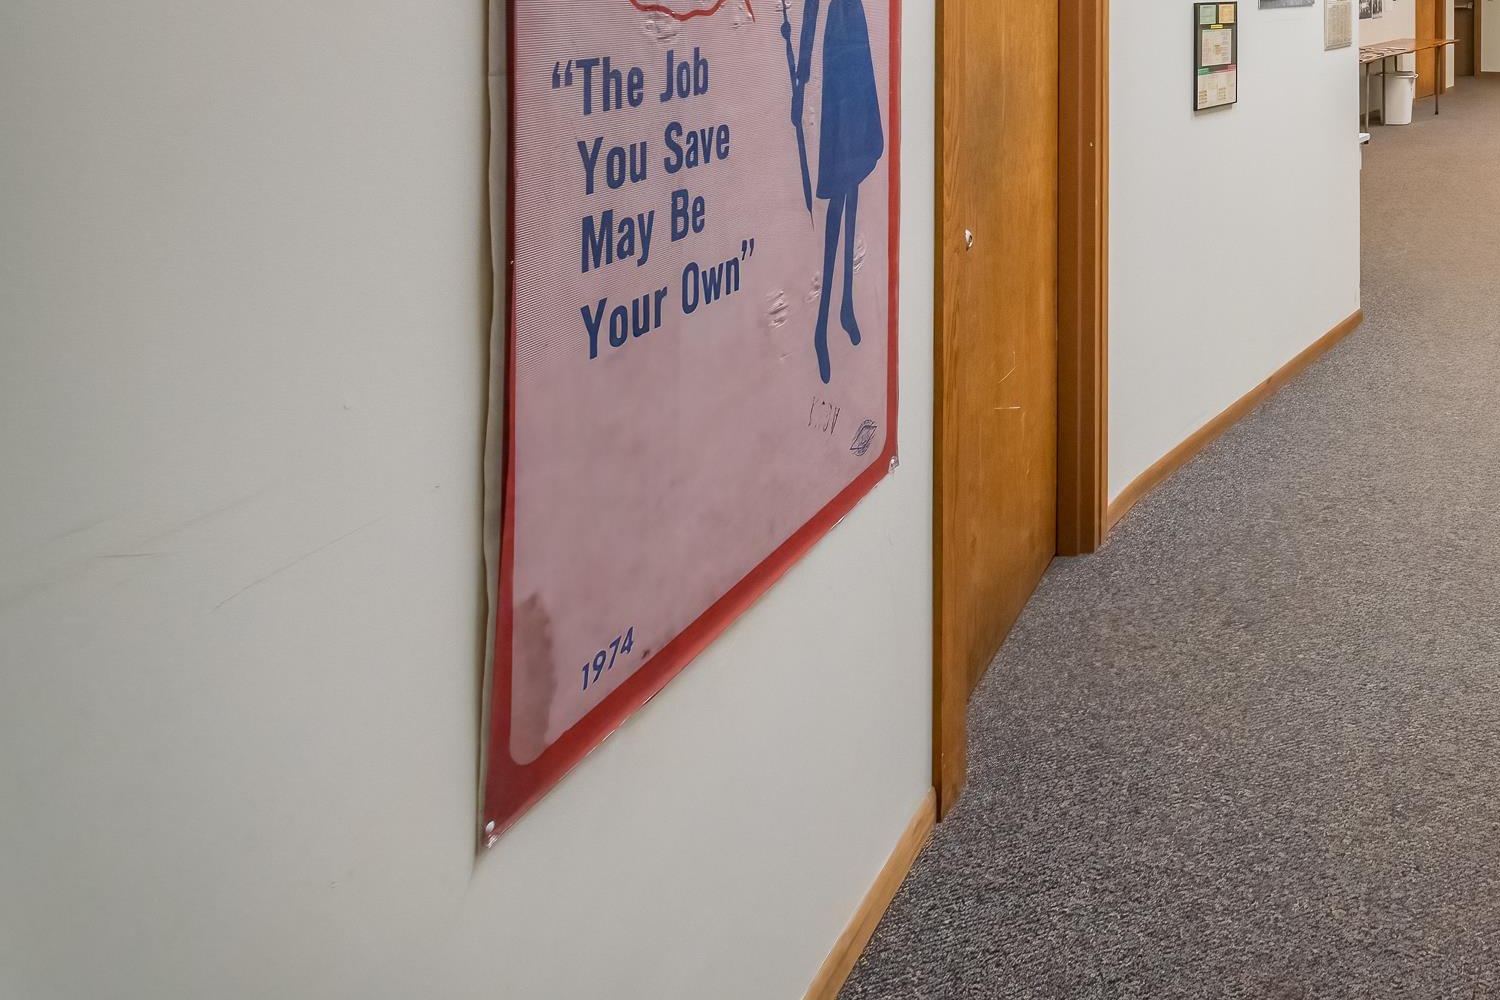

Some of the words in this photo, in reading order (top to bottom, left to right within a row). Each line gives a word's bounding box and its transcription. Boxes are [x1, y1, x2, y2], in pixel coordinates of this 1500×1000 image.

[660, 46, 709, 103] Job
[577, 137, 647, 195] You
[664, 121, 731, 175] Save
[581, 207, 655, 274] May
[671, 187, 706, 243] Be
[580, 285, 668, 360] Your
[581, 626, 634, 691] 1974
